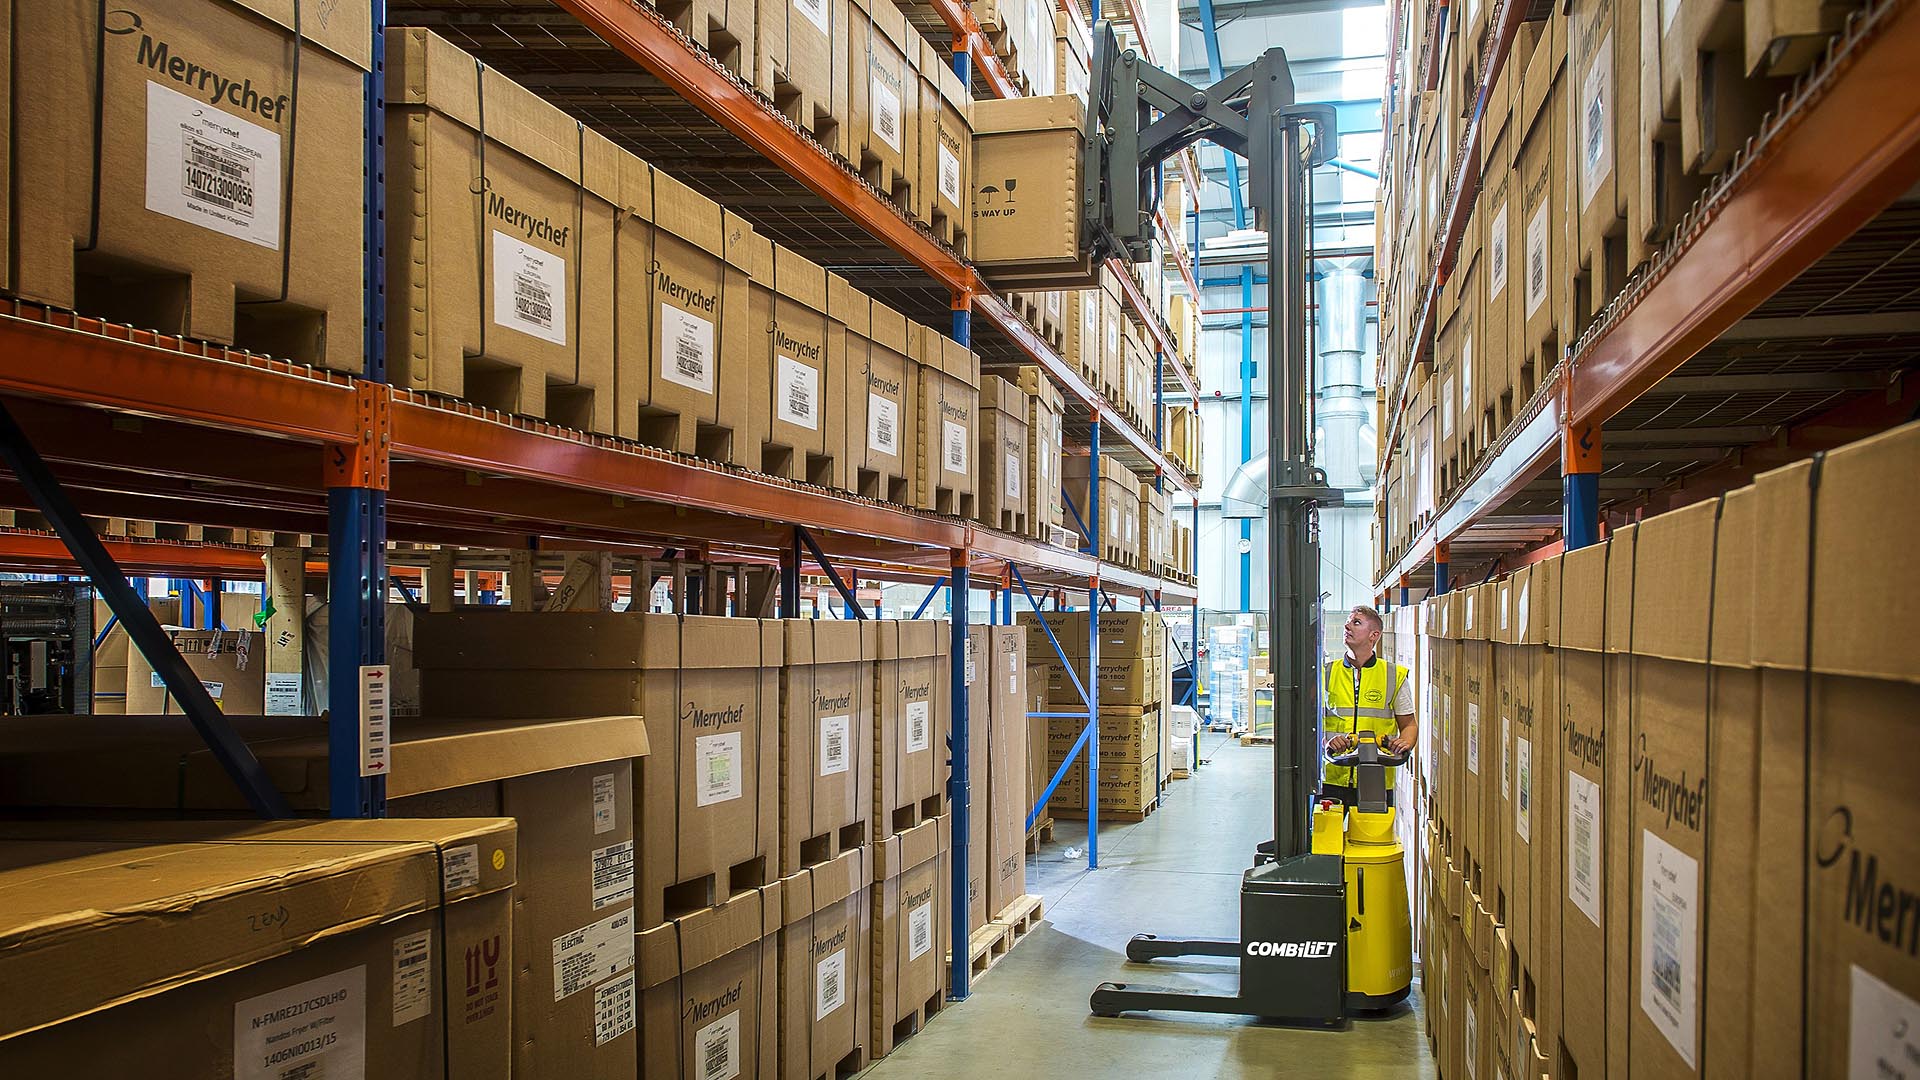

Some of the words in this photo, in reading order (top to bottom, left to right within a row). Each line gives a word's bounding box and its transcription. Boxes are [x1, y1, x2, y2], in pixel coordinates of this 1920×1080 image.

[137, 33, 290, 124] Merrychef
[202, 119, 240, 139] merrychef
[186, 166, 253, 207] 1407213090856
[488, 196, 570, 248] Merrychef
[981, 209, 1001, 217] WAY
[1003, 208, 1016, 217] UP
[657, 273, 717, 313] Merrychef
[775, 331, 821, 360] Merrychef
[868, 373, 900, 397] Merrychef
[942, 400, 968, 421] Merrychef
[1098, 618, 1129, 627] errychef
[1100, 664, 1130, 673] errychef
[817, 691, 850, 713] Merrychef
[904, 682, 929, 700] Merrychef
[692, 703, 744, 730] Merrychef
[1101, 733, 1131, 741] errychef
[1568, 719, 1605, 769] Merrychef
[1101, 780, 1131, 788] errychef
[1642, 758, 1707, 832] Merrychef
[561, 934, 585, 951] ELECTRIC
[815, 924, 848, 956] Merrychef
[692, 980, 743, 1025] Merrychef
